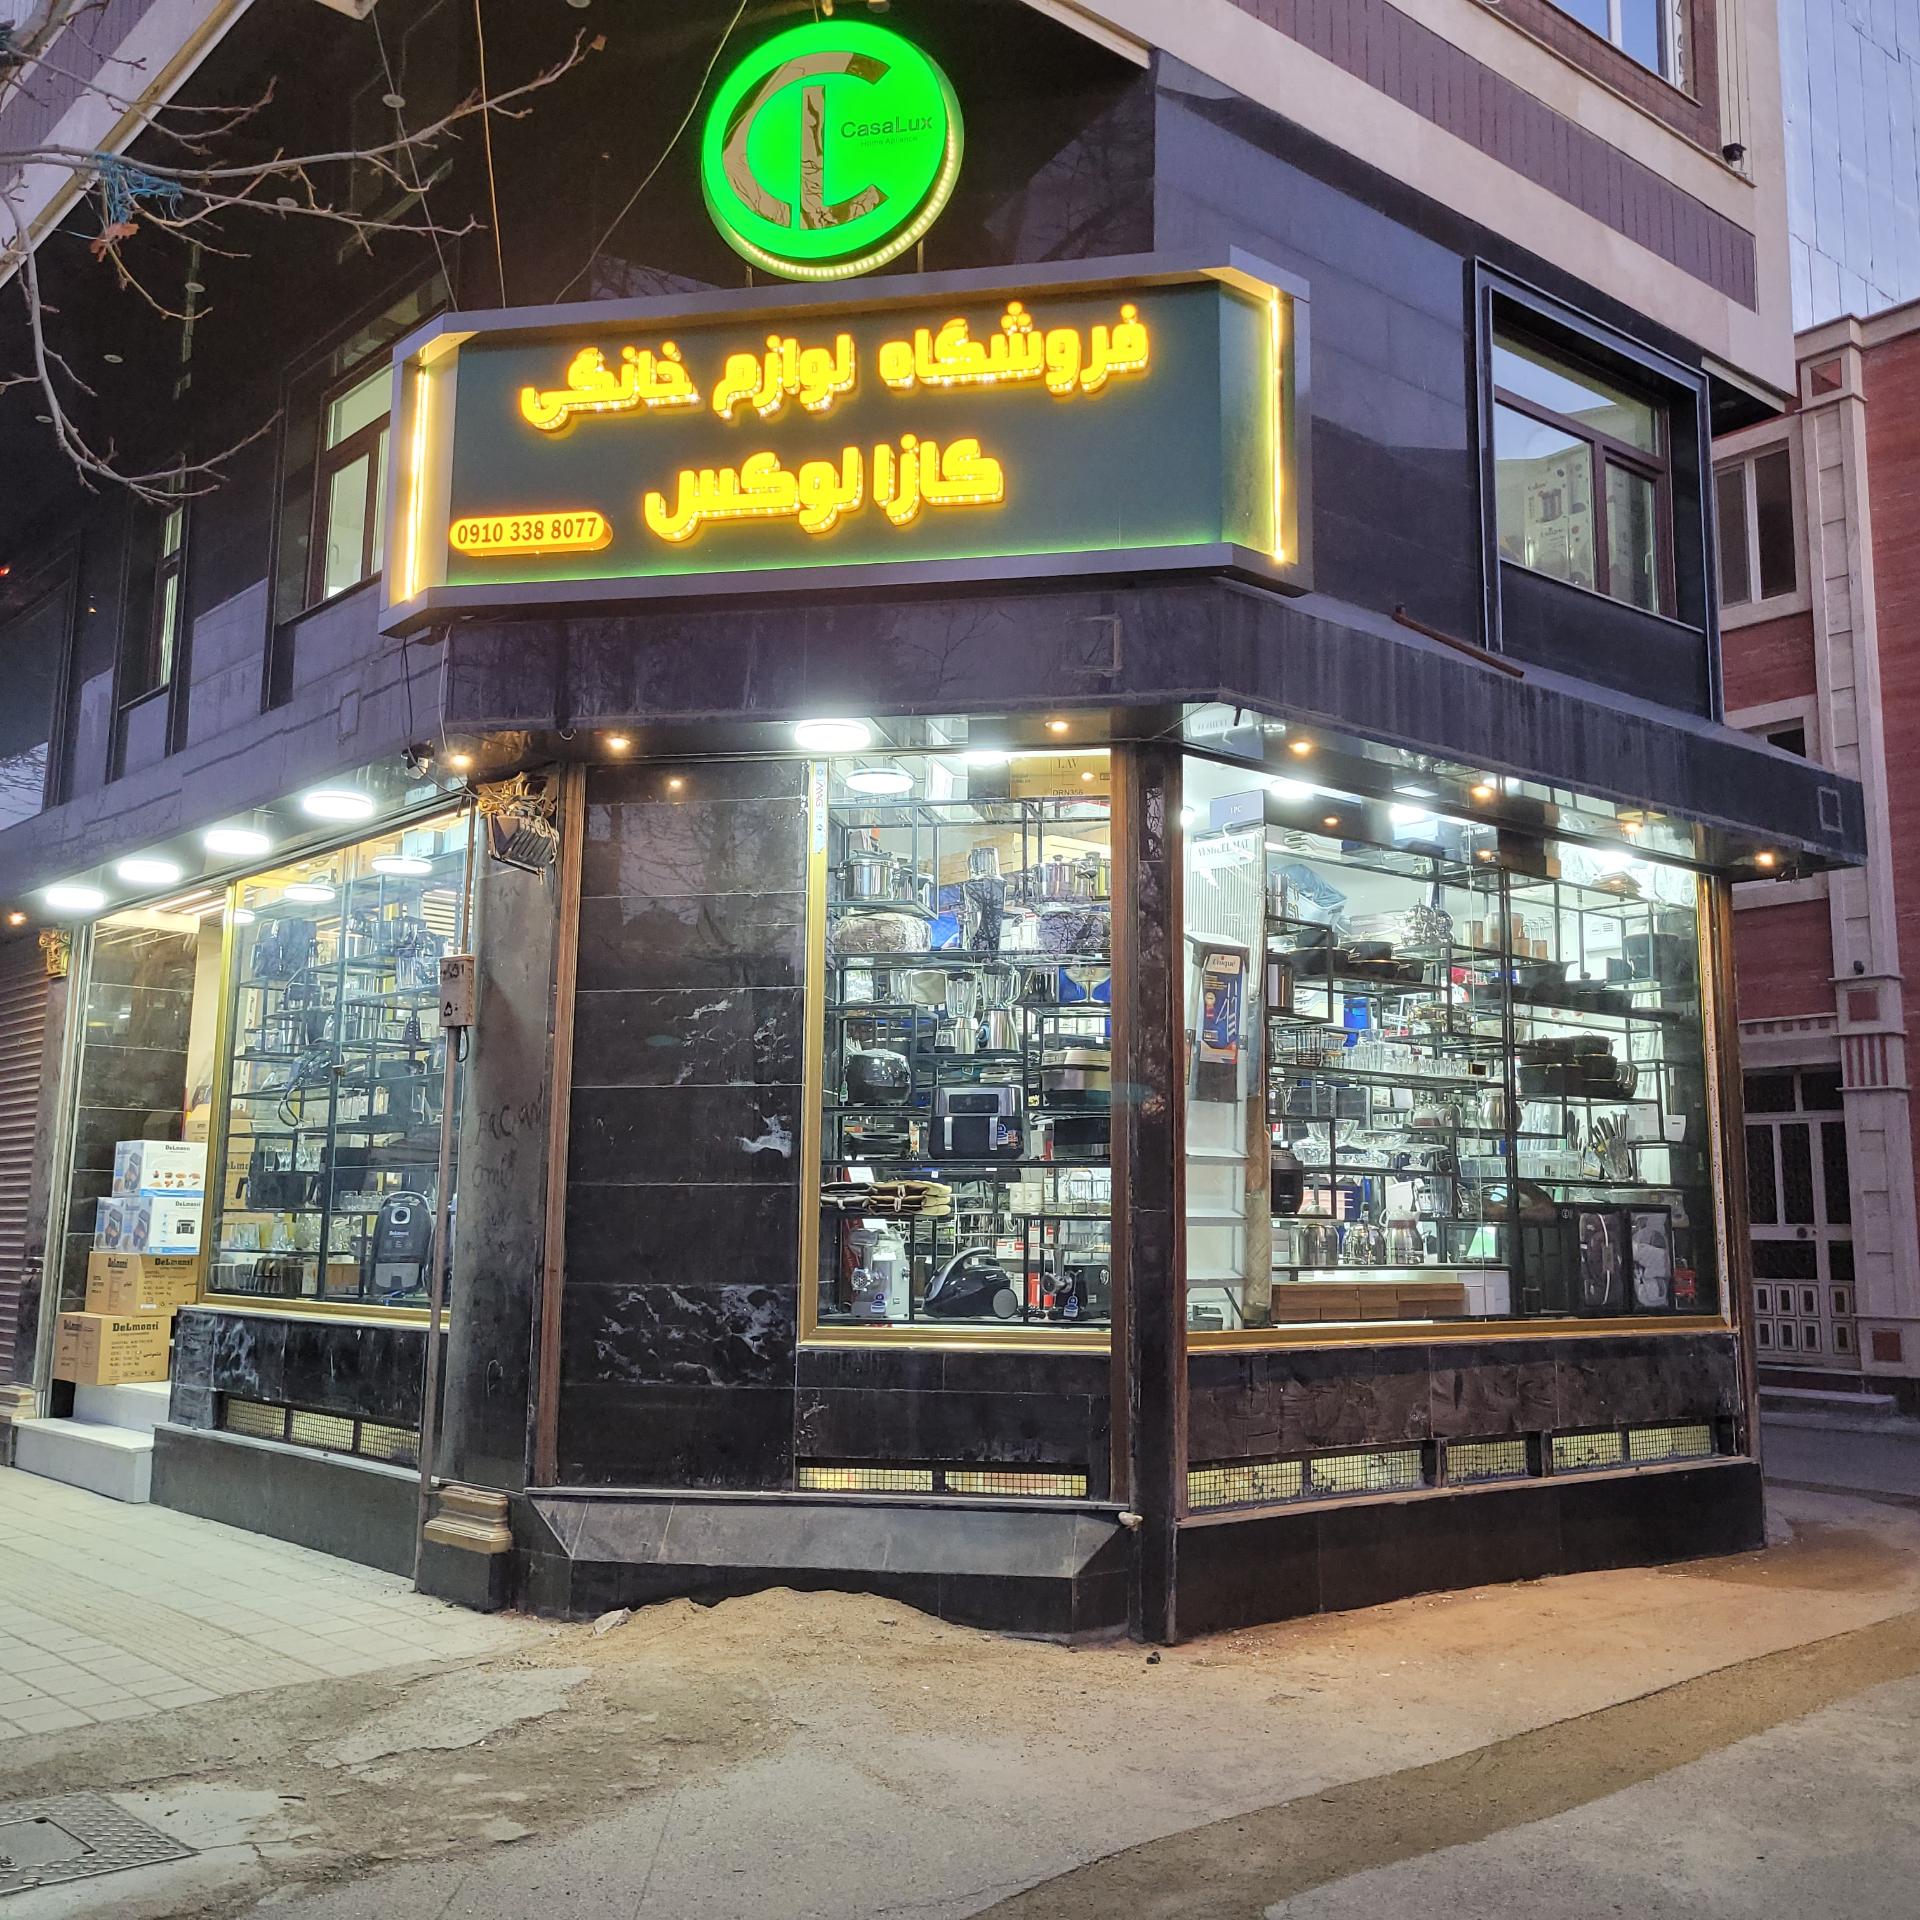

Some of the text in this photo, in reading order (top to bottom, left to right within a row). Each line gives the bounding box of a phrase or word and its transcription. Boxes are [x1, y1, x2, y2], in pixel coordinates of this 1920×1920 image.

[840, 116, 932, 138] CasaLux
[521, 302, 1149, 430] فروشگاه لوازم خانگی
[644, 433, 1005, 542] کازا لوکس
[457, 517, 597, 544] 0910 338 8077
[112, 1322, 160, 1332] DeLmonti
